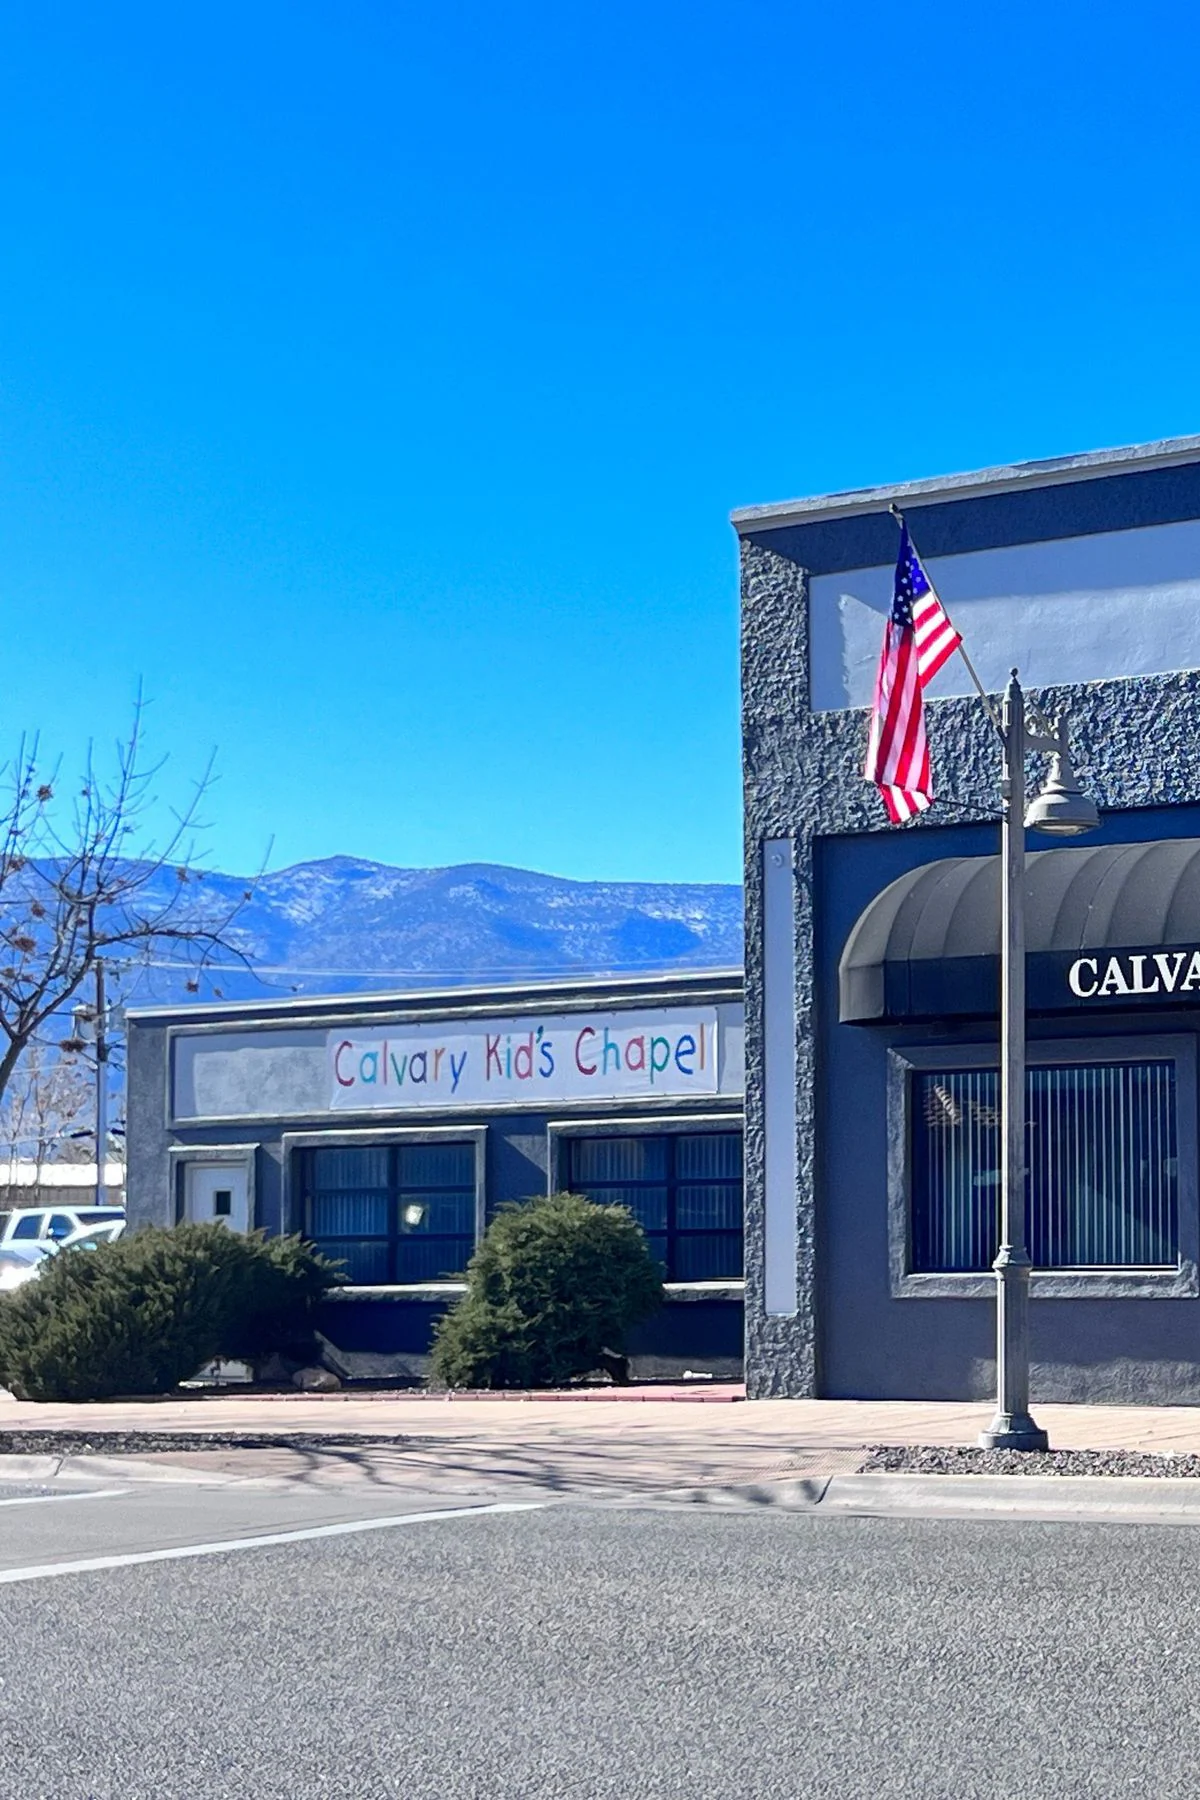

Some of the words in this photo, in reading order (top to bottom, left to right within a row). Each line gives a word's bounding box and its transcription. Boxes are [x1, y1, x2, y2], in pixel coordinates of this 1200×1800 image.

[334, 1040, 468, 1094] Calvary
[485, 1025, 555, 1081] Kid's
[575, 1022, 705, 1085] Chapel
